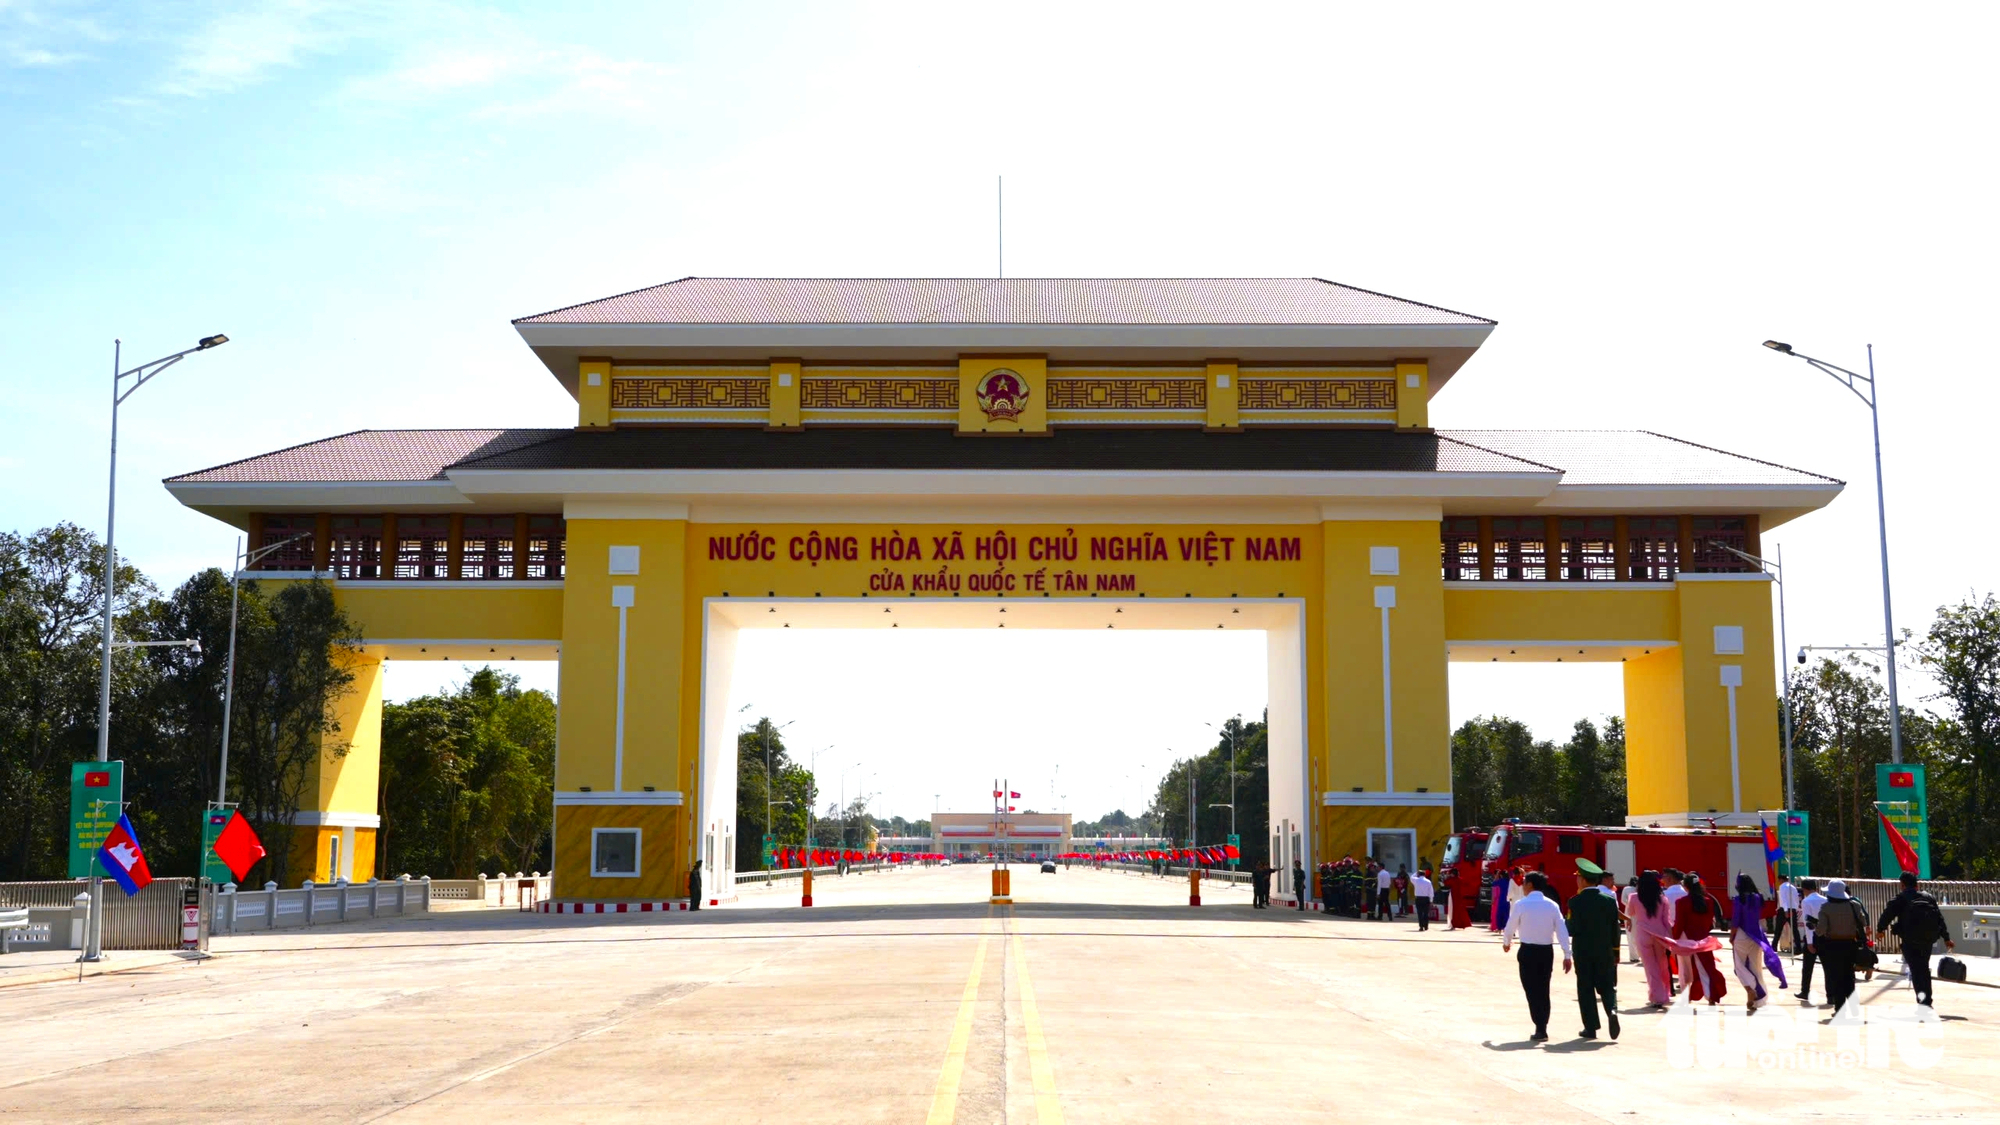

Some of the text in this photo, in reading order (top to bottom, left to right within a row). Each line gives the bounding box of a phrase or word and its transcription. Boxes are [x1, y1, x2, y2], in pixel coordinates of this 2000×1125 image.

[708, 528, 1302, 566] NƯỚC CỘNG HÒA XÃ HỘI CHỦ NGHĨA VIỆT NAM
[869, 565, 1136, 592] CỬA KHẨU QUỐC TẾ TÂN NAM
